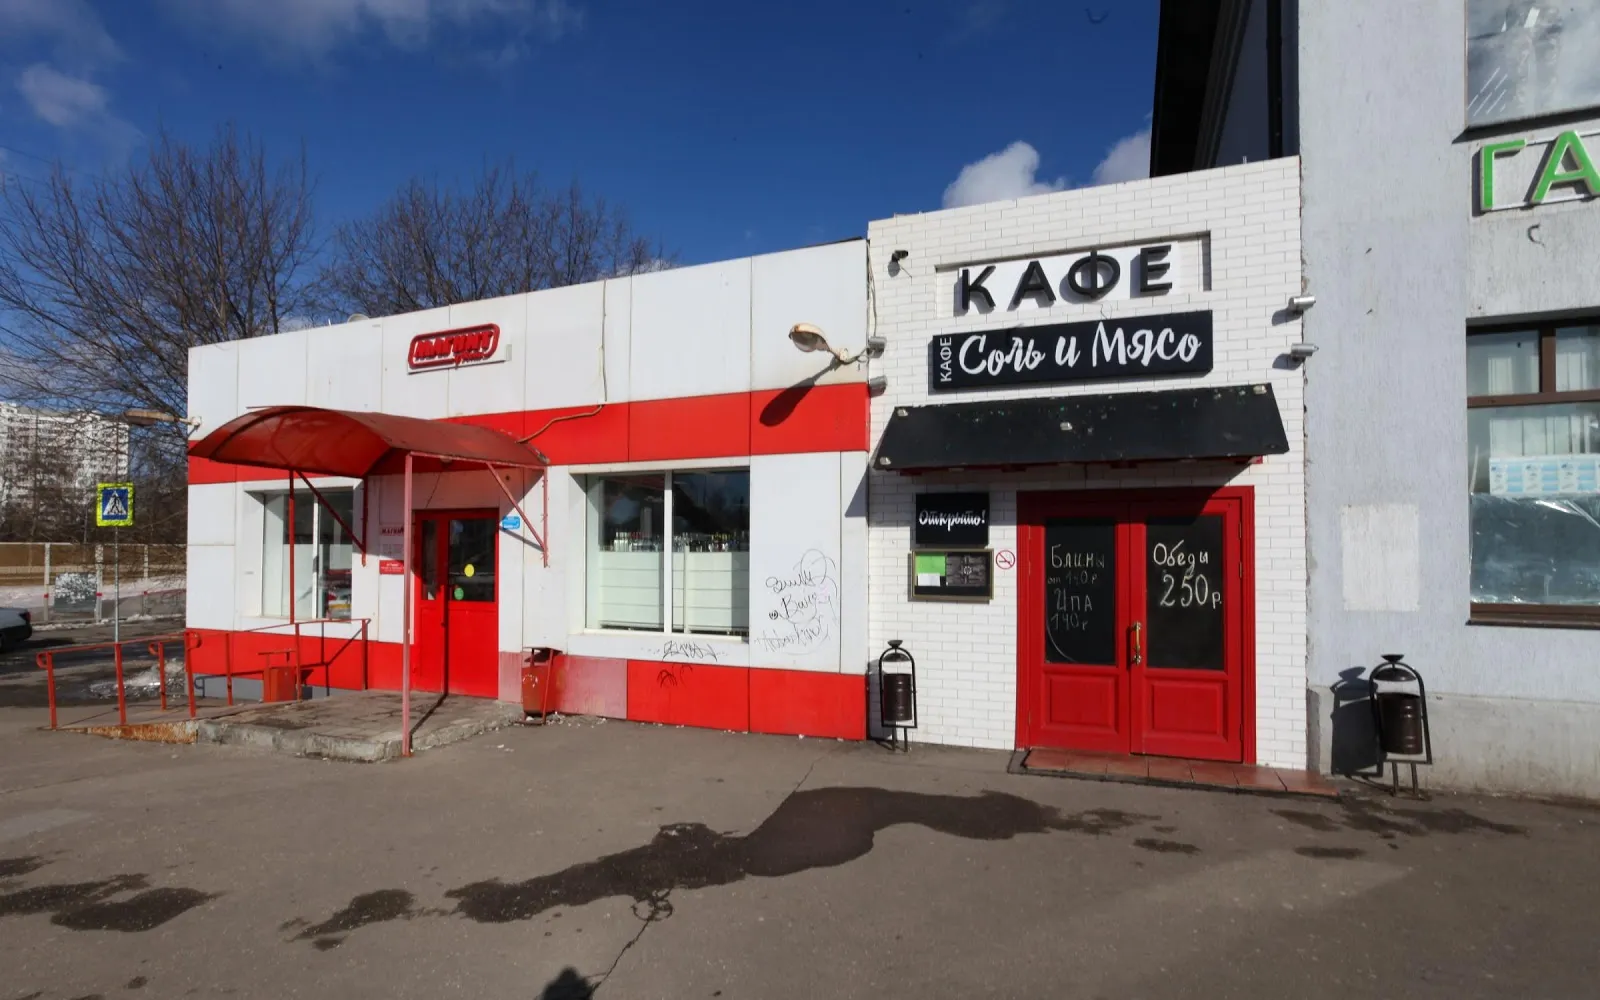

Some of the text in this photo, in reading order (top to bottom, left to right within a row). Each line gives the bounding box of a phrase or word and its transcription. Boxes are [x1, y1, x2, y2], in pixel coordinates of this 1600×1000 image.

[961, 244, 1172, 311] КАФЕ
[940, 337, 952, 382] КАФЕ
[958, 321, 1201, 376] Соль и Мясо
[918, 509, 986, 532] Открыто!
[1051, 544, 1105, 568] Блины
